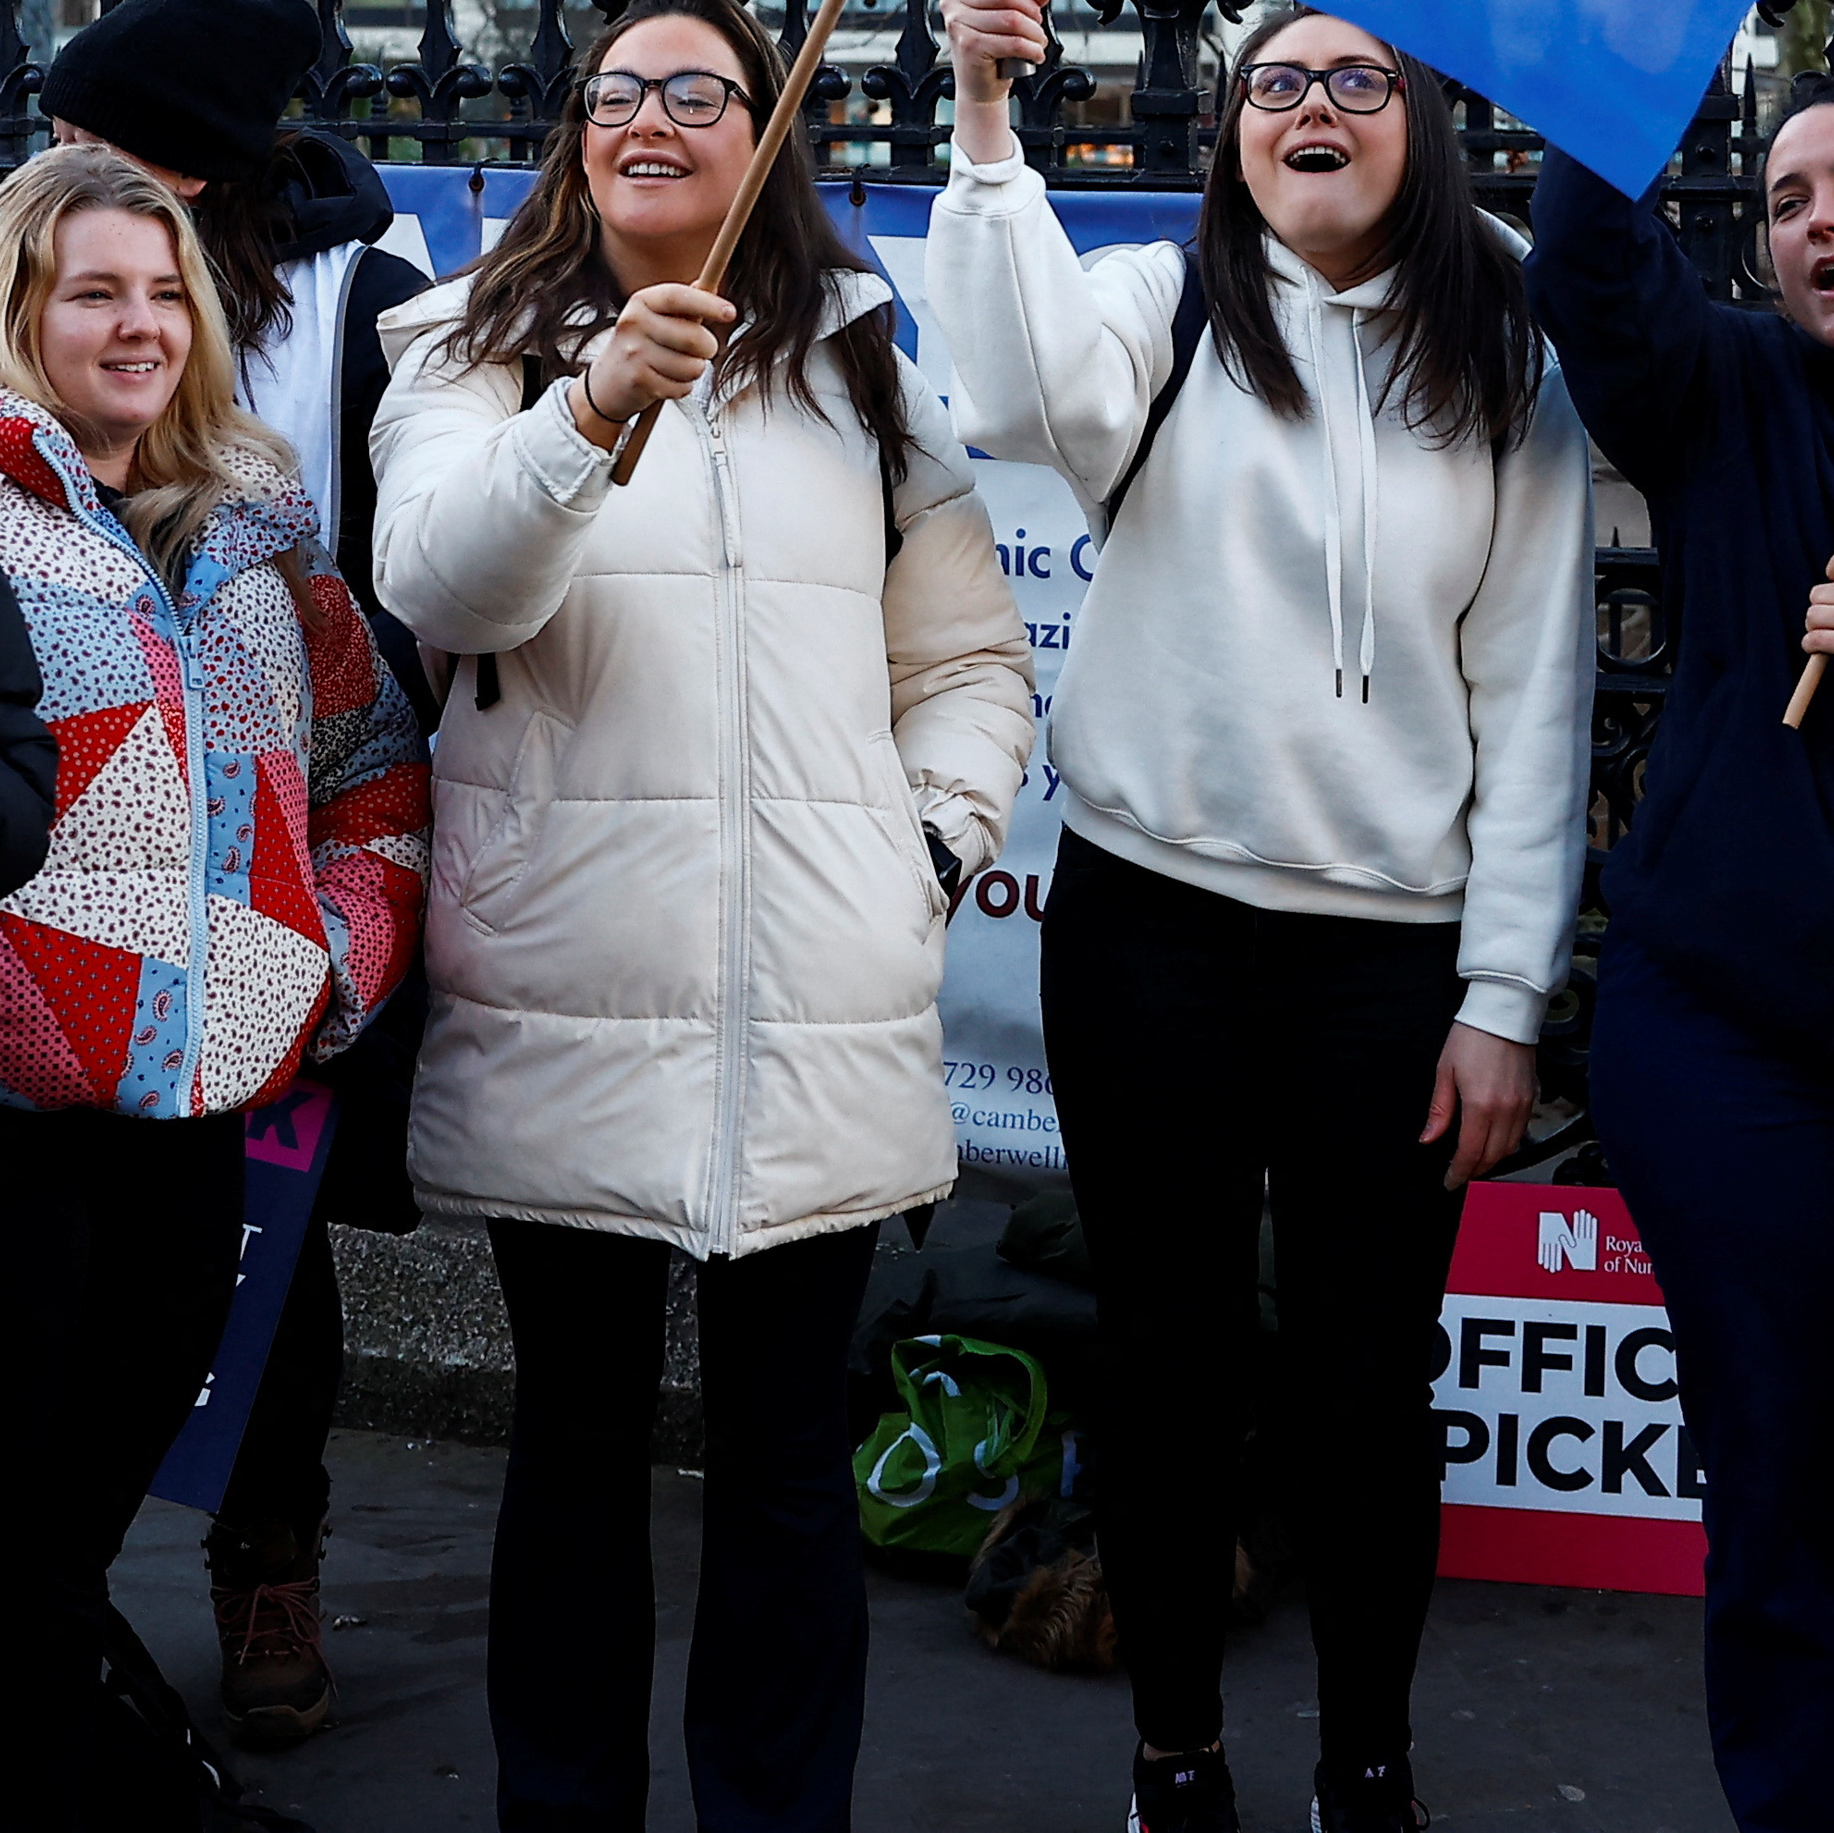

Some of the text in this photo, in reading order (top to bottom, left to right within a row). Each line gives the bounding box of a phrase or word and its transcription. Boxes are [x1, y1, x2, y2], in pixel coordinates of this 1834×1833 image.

[950, 1101, 1062, 1133] @cambe
[1605, 1235, 1645, 1258] Roya
[1604, 1256, 1655, 1275] of Nur
